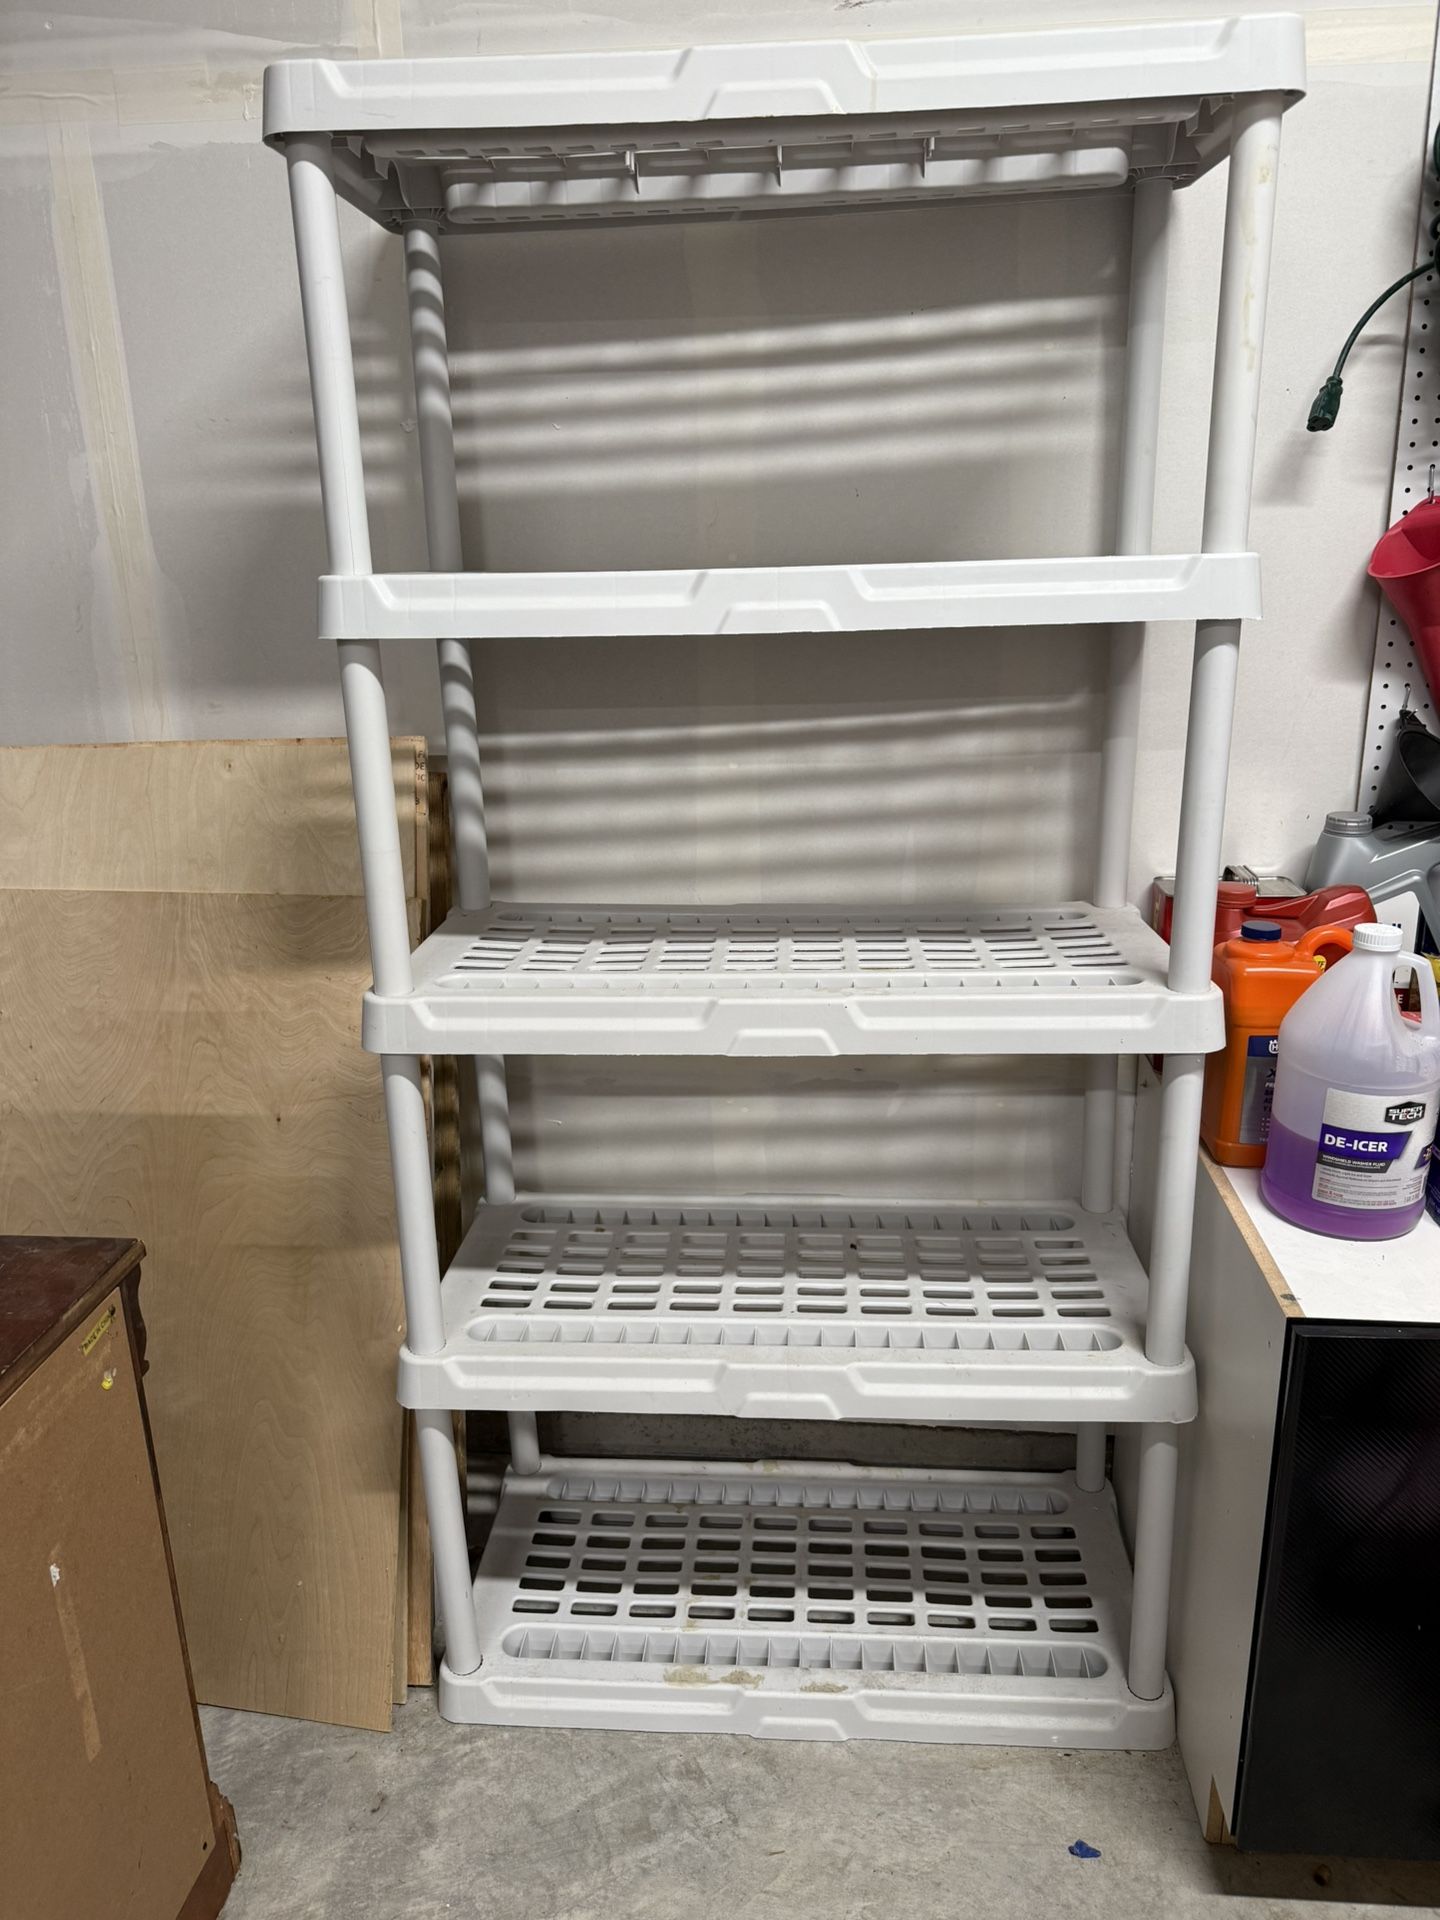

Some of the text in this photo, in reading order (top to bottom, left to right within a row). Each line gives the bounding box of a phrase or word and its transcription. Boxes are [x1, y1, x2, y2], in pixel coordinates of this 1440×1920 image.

[1389, 1106, 1423, 1114] SUPER
[1388, 1111, 1422, 1120] TECH
[1324, 1134, 1388, 1152] DE-ICER
